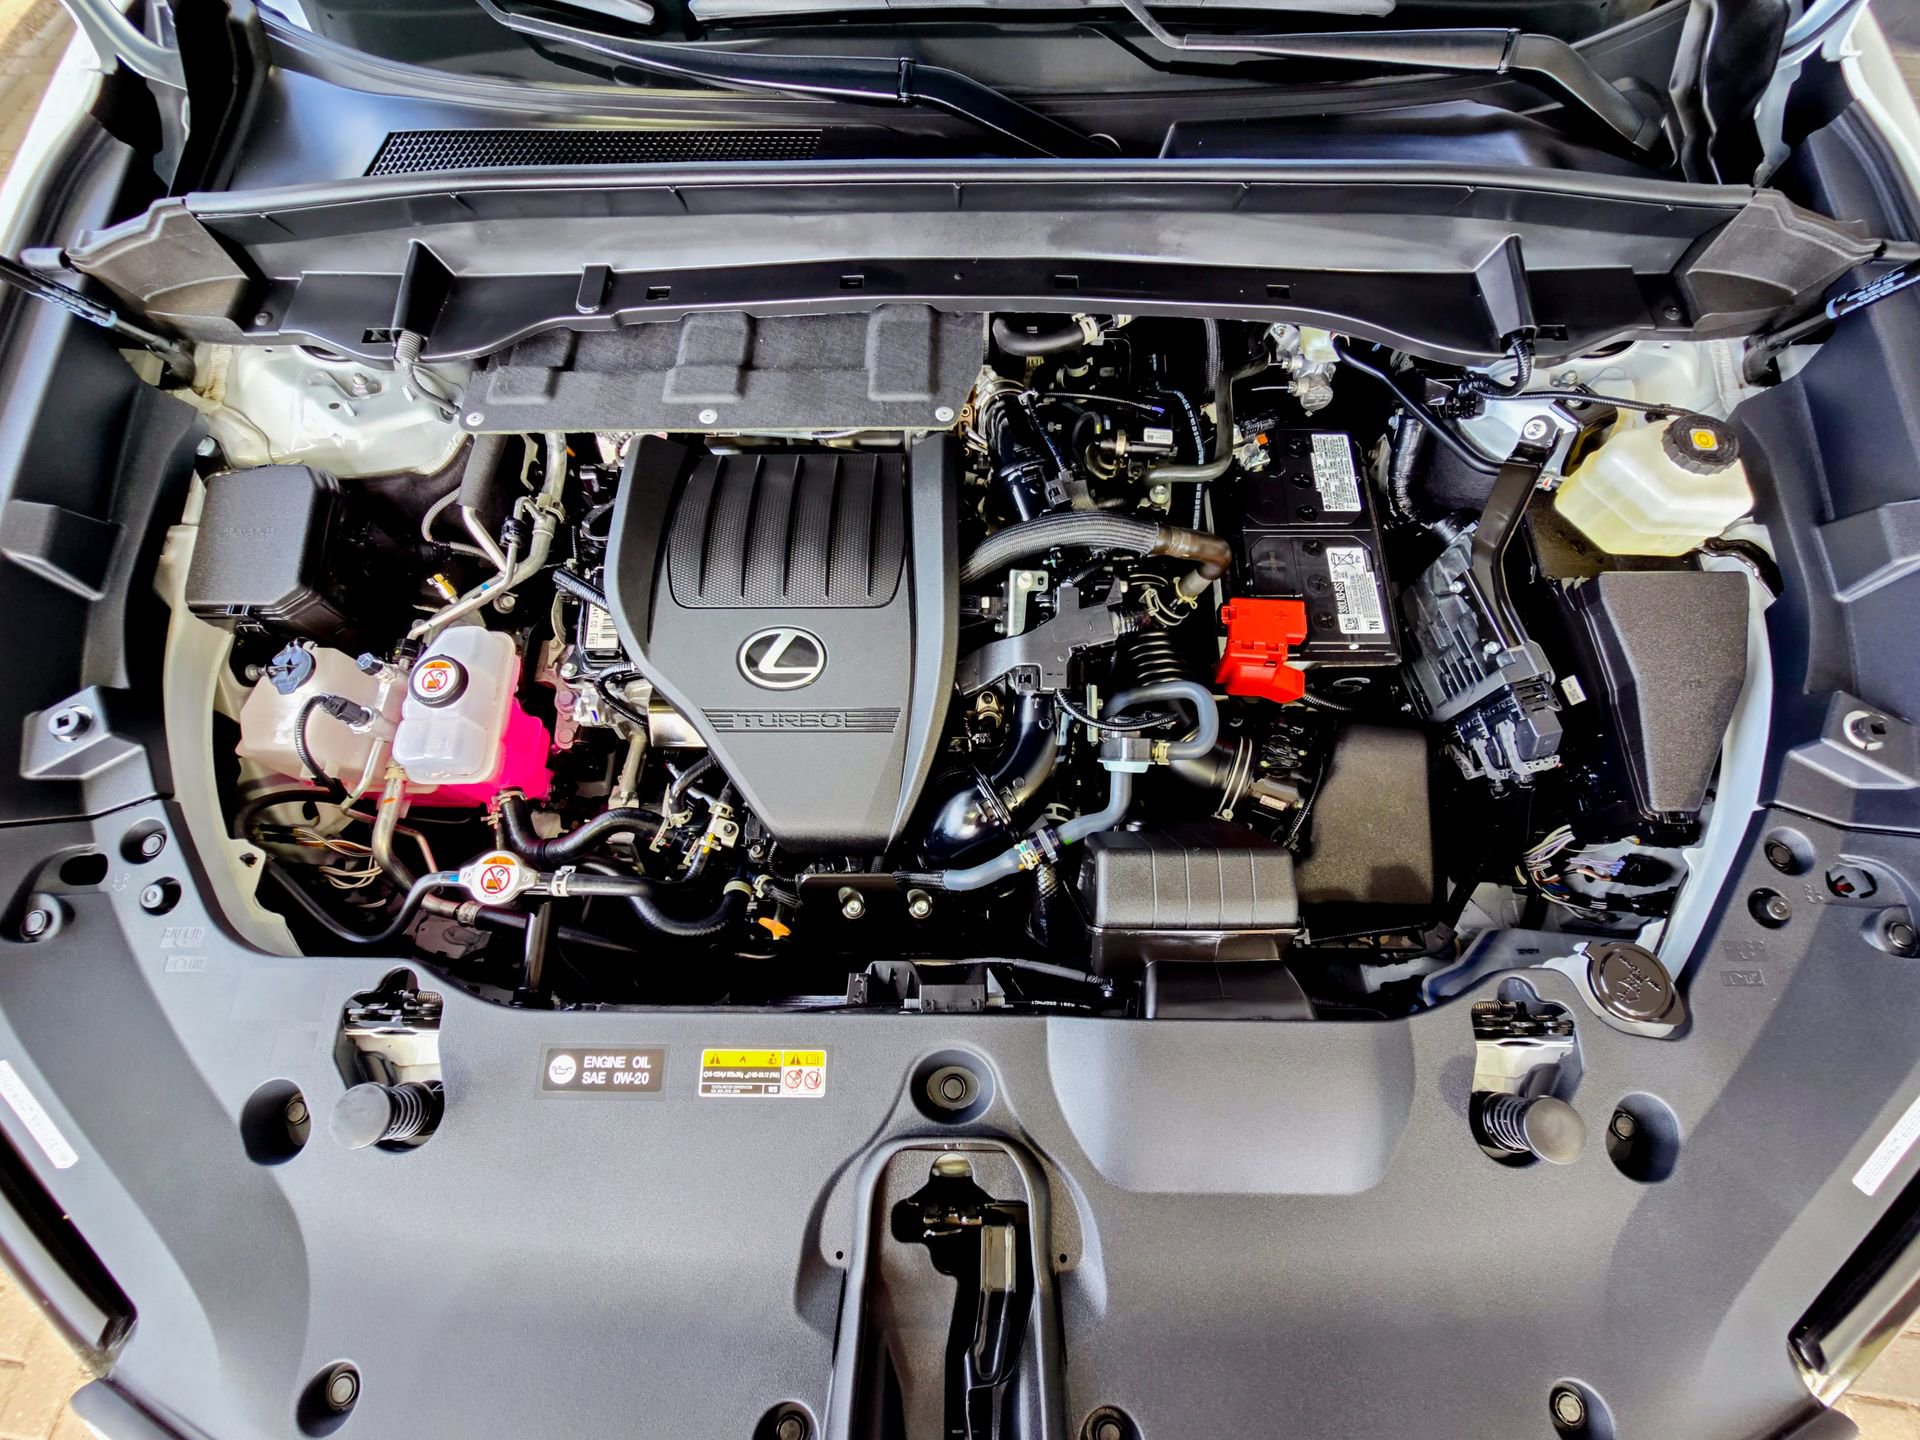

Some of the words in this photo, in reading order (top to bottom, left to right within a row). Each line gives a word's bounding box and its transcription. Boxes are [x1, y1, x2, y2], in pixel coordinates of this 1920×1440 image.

[736, 712, 843, 729] TURBO
[583, 1056, 626, 1068] ENGINE
[632, 1056, 651, 1068] OIL
[581, 1072, 605, 1084] SAE
[613, 1073, 649, 1085] 0W-20
